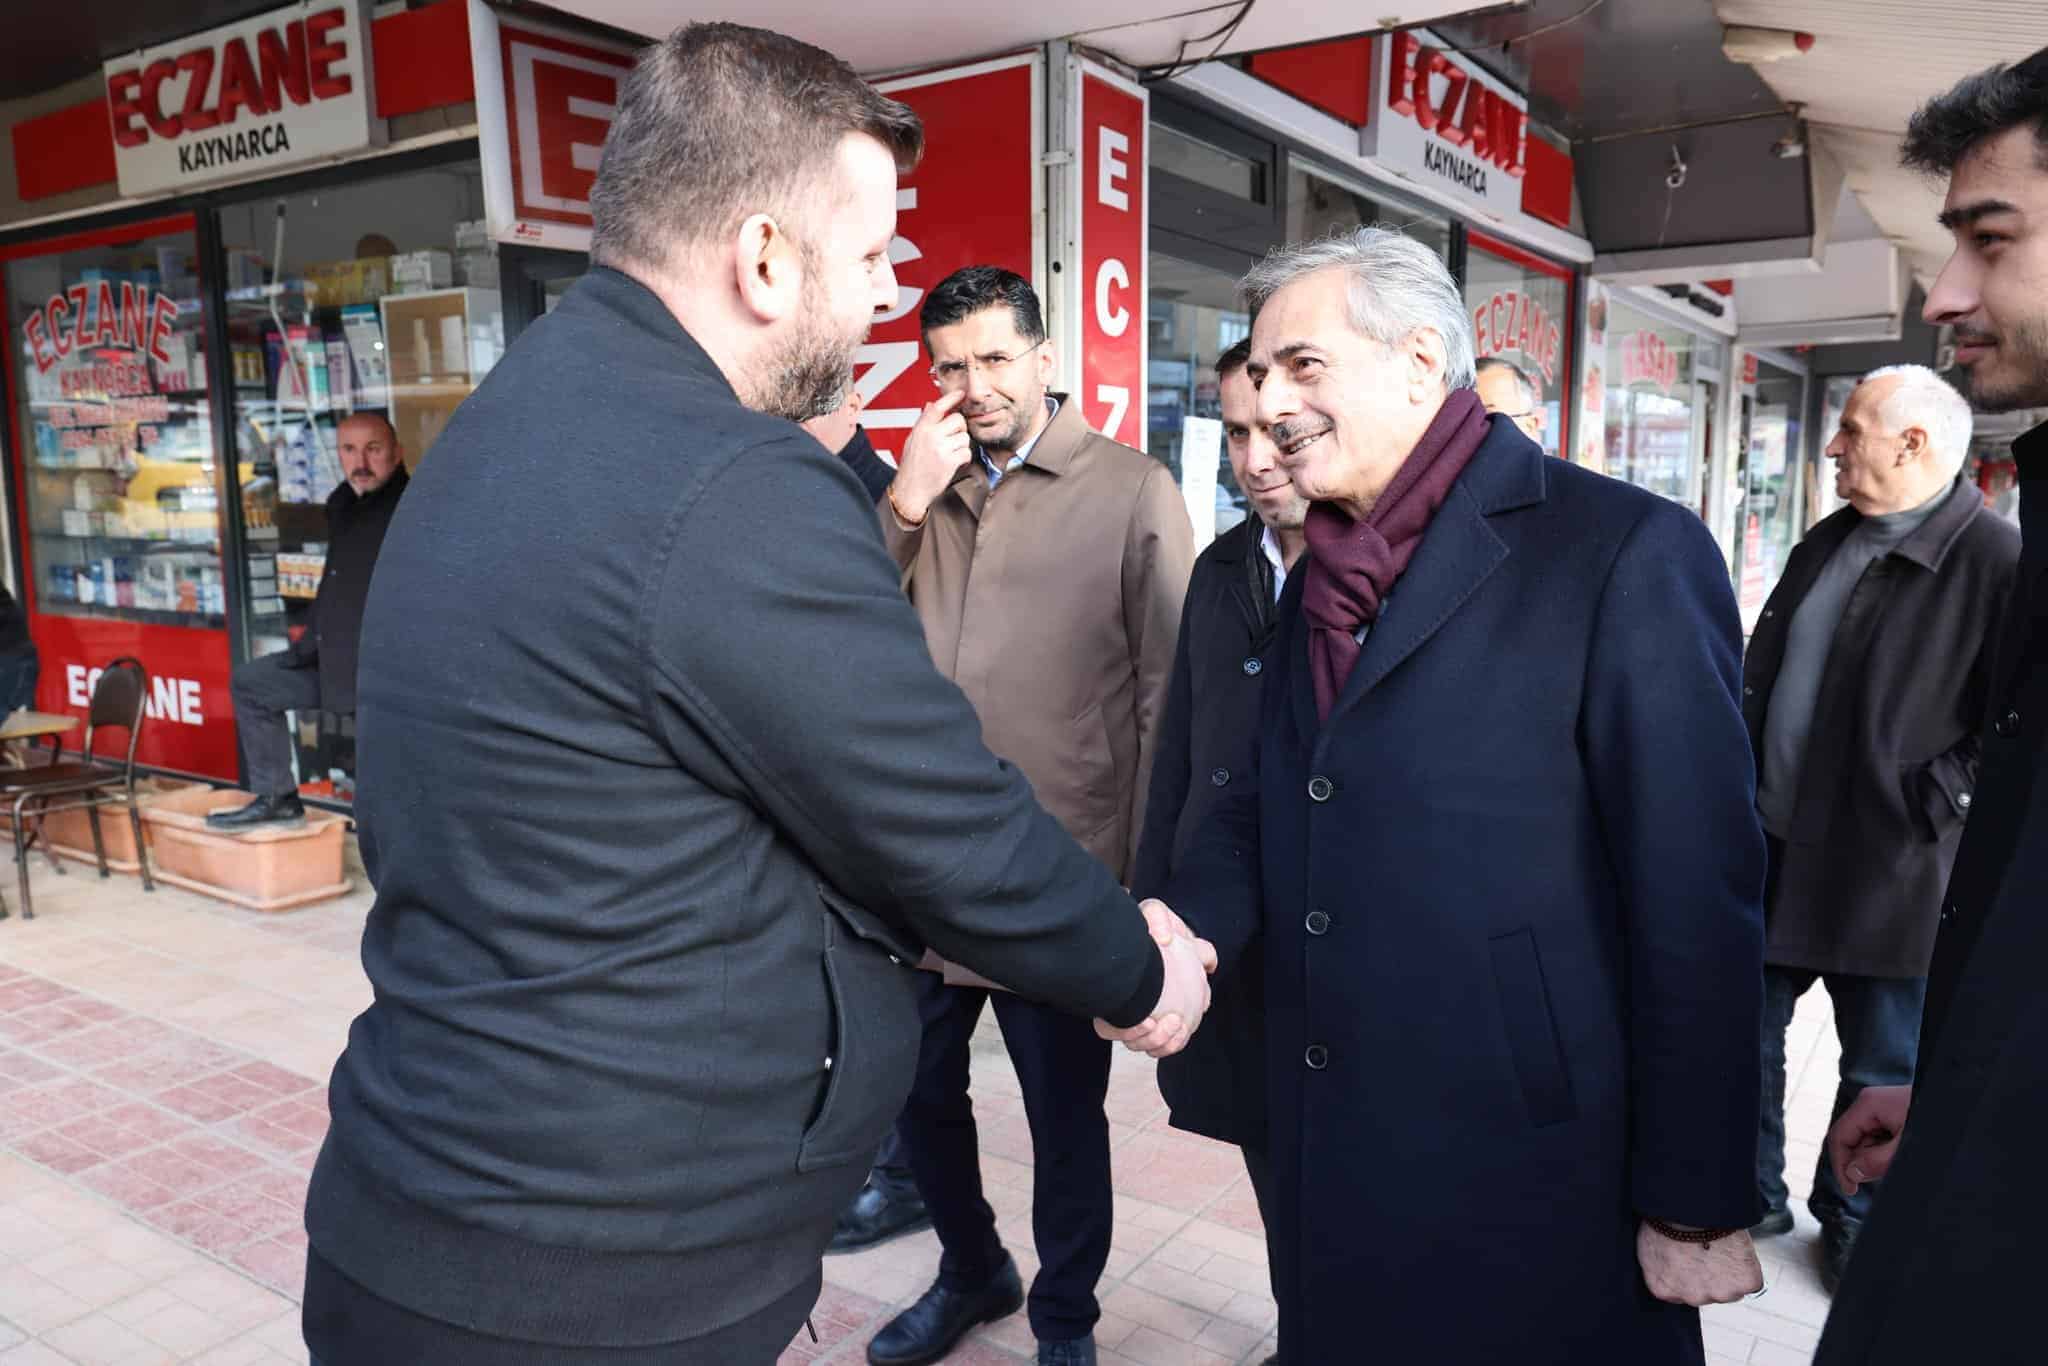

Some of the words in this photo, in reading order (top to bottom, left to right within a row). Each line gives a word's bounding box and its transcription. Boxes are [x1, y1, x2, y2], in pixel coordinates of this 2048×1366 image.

[108, 7, 353, 148] ECZANE
[178, 122, 290, 173] KAYNARCA
[1424, 141, 1488, 197] KAYNARCA
[23, 279, 178, 376] ECZANE
[1474, 291, 1559, 386] ECZANE
